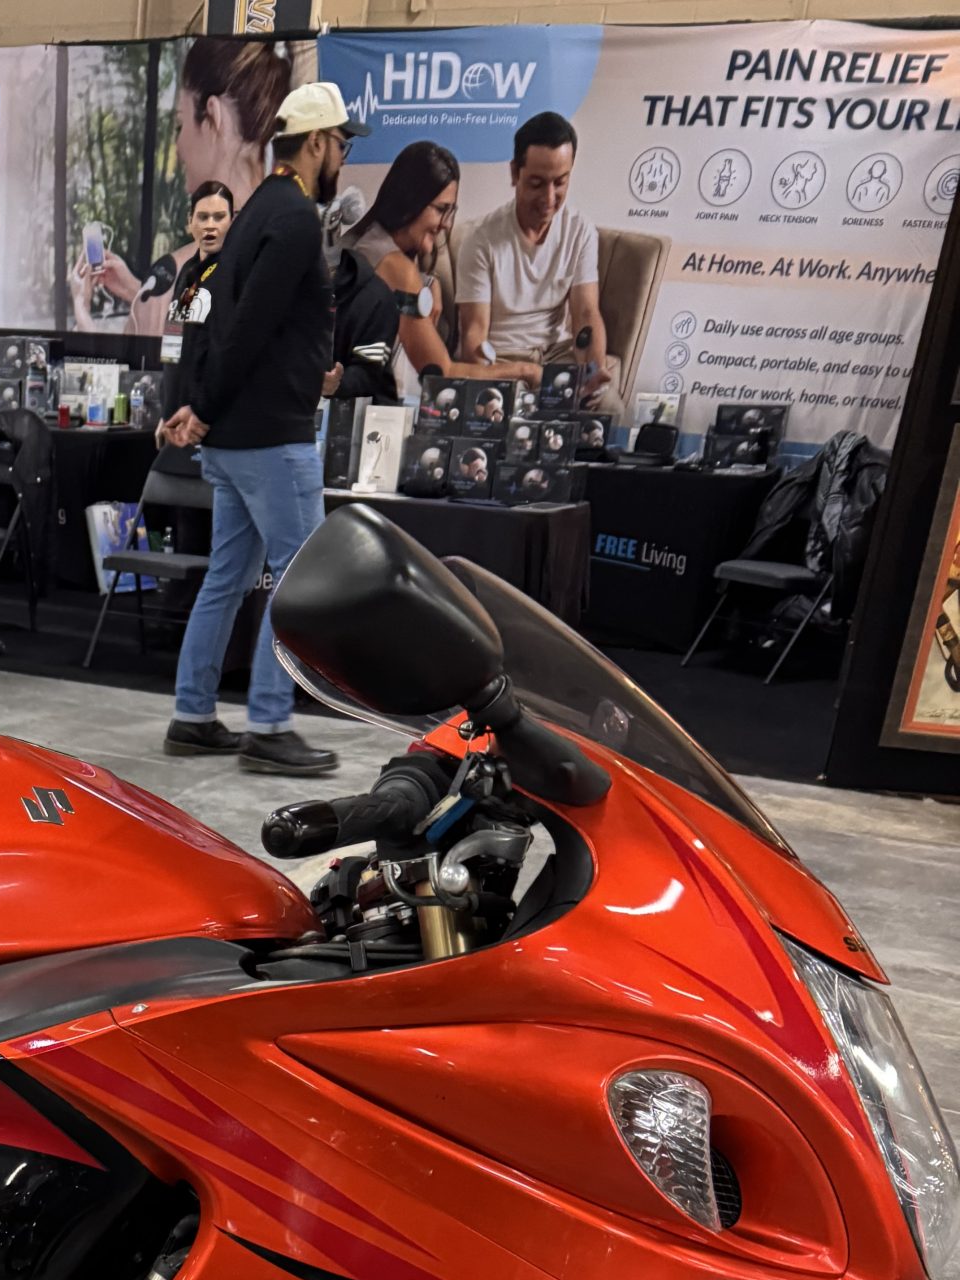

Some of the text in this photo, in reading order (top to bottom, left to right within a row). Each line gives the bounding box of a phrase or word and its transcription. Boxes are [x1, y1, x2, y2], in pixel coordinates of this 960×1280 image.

[725, 48, 949, 84] PAIN RELIEF
[382, 112, 518, 127] Dedicated to Pain-Free Living
[643, 95, 737, 128] THAT
[739, 96, 817, 129] FITS
[825, 97, 930, 131] YOUR
[628, 208, 669, 218] BACK PAIN
[695, 211, 739, 221] JOINT PAIN
[758, 214, 818, 225] NECK TENSION
[842, 217, 884, 227] SORENESS
[902, 219, 933, 229] FASTER
[681, 252, 706, 272] At
[708, 253, 765, 276] Home.
[769, 257, 795, 277] At
[798, 259, 851, 281] Work.
[703, 319, 905, 347] Daily use across all age groups.
[697, 350, 758, 370] Compact,
[759, 355, 820, 374] portable,
[822, 359, 851, 375] and
[851, 364, 883, 380] easy
[885, 364, 900, 378] to
[690, 380, 902, 410] Perfect for work, home, or travel.
[594, 532, 687, 575] FREE Living
